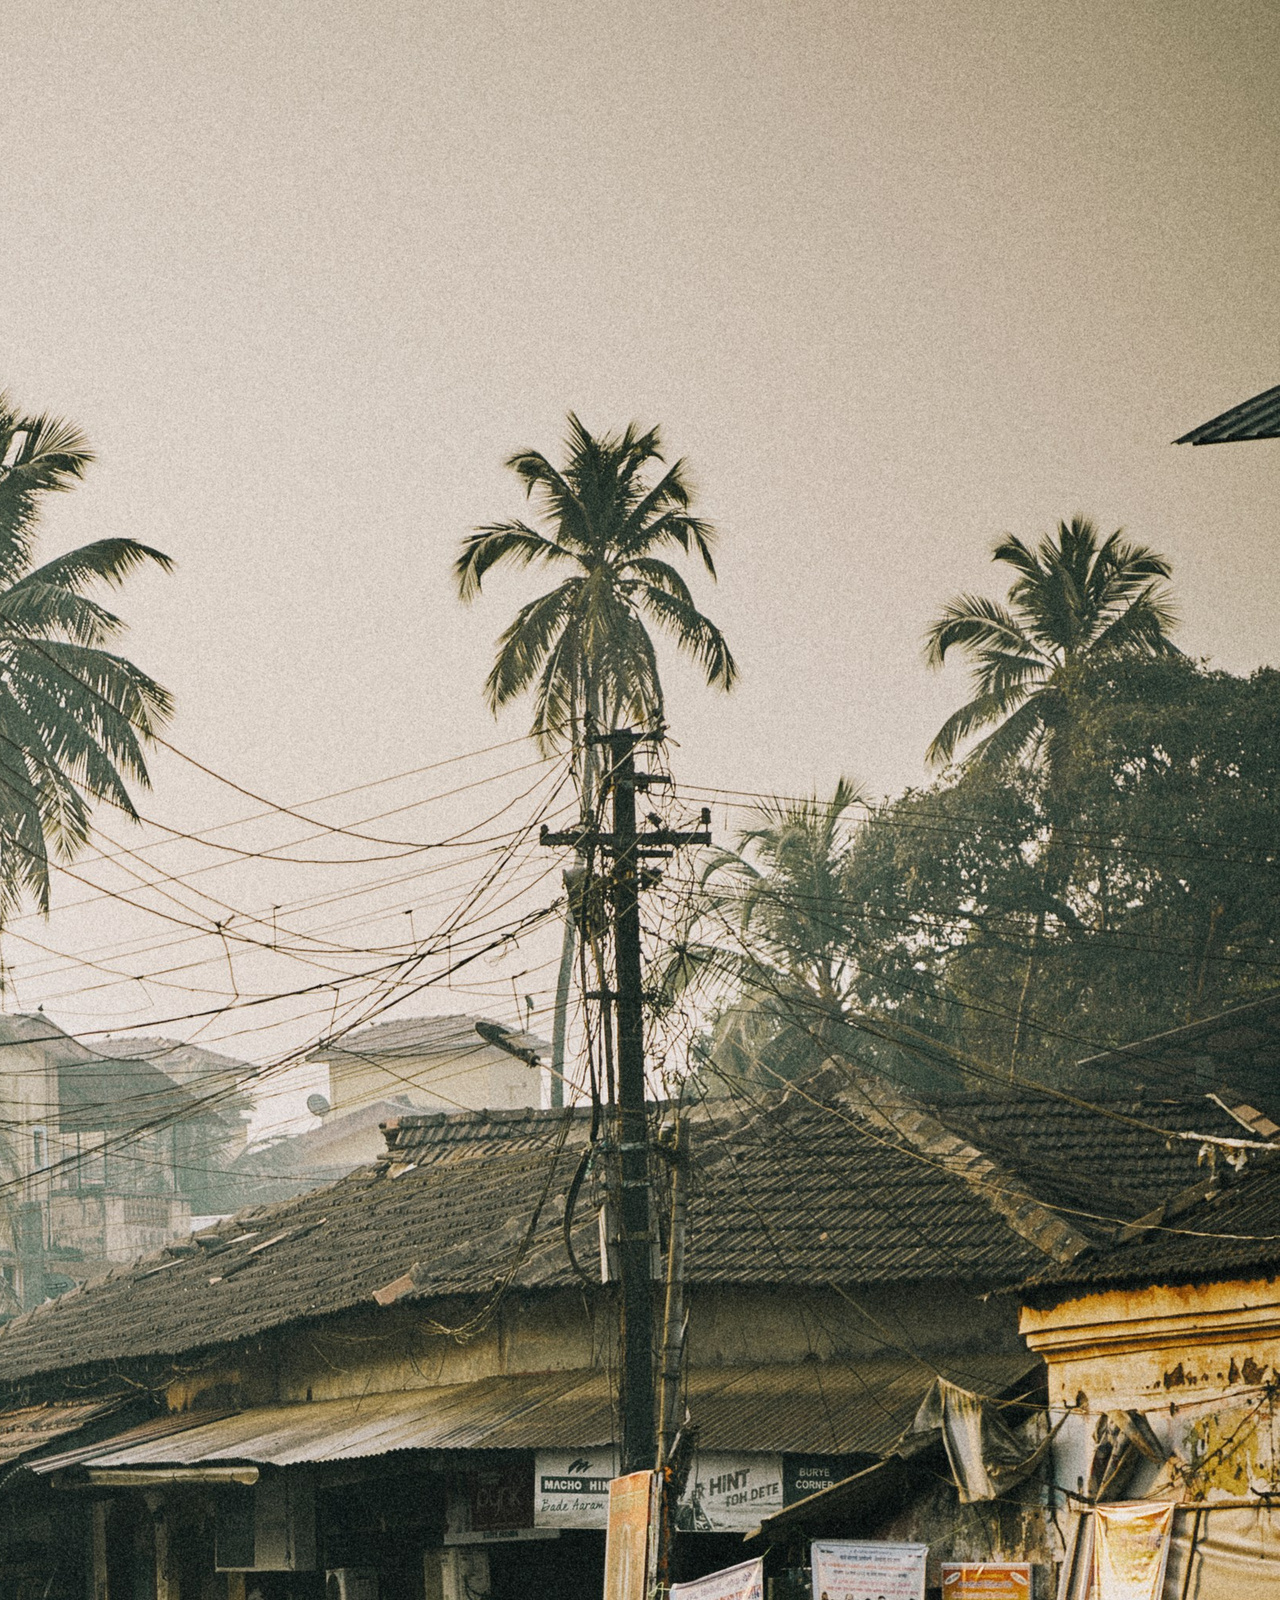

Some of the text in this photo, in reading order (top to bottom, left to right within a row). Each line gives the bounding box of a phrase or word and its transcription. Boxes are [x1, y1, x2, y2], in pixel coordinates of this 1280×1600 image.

[544, 1480, 582, 1490] MACHO
[709, 1468, 750, 1496] HINT
[750, 1482, 779, 1501] DETE
[540, 1498, 569, 1512] Bade
